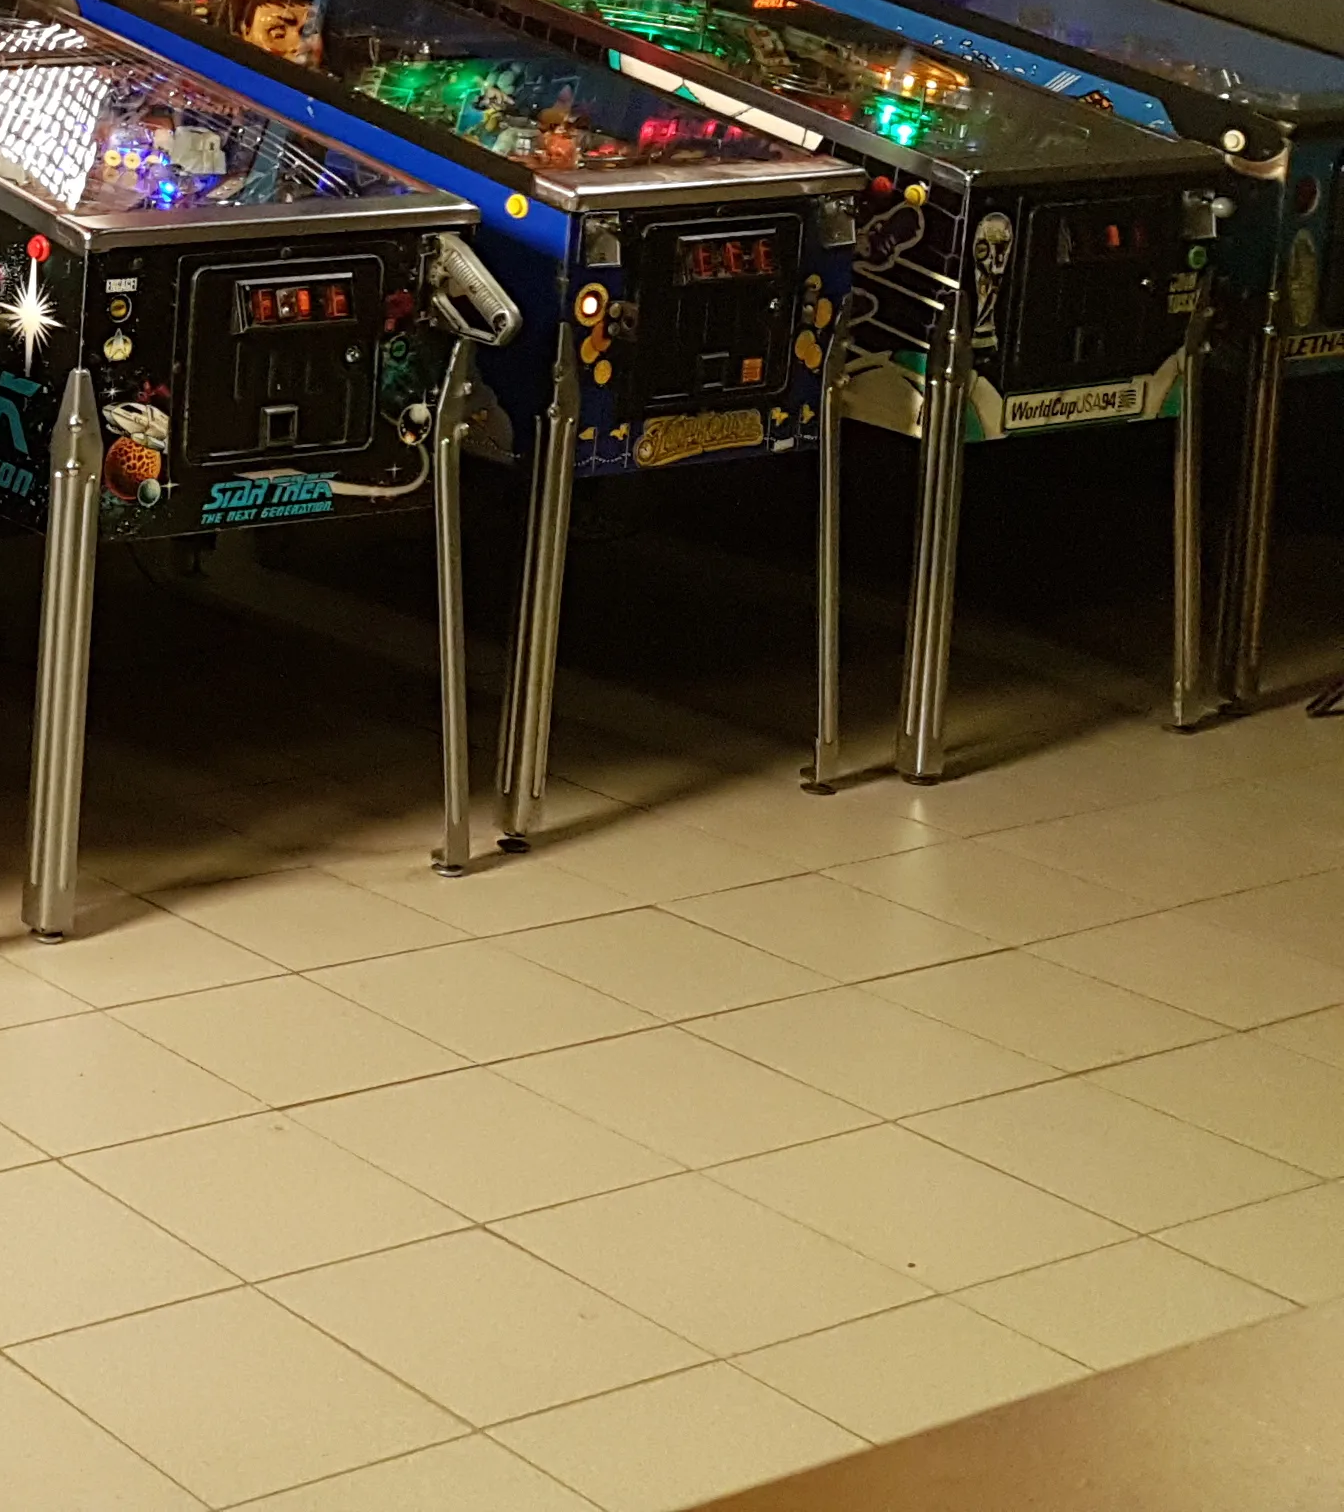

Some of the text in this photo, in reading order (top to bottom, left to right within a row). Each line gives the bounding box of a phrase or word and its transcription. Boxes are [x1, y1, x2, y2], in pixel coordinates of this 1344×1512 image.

[202, 471, 338, 510] STAR TREK
[201, 508, 256, 525] THE NEXT
